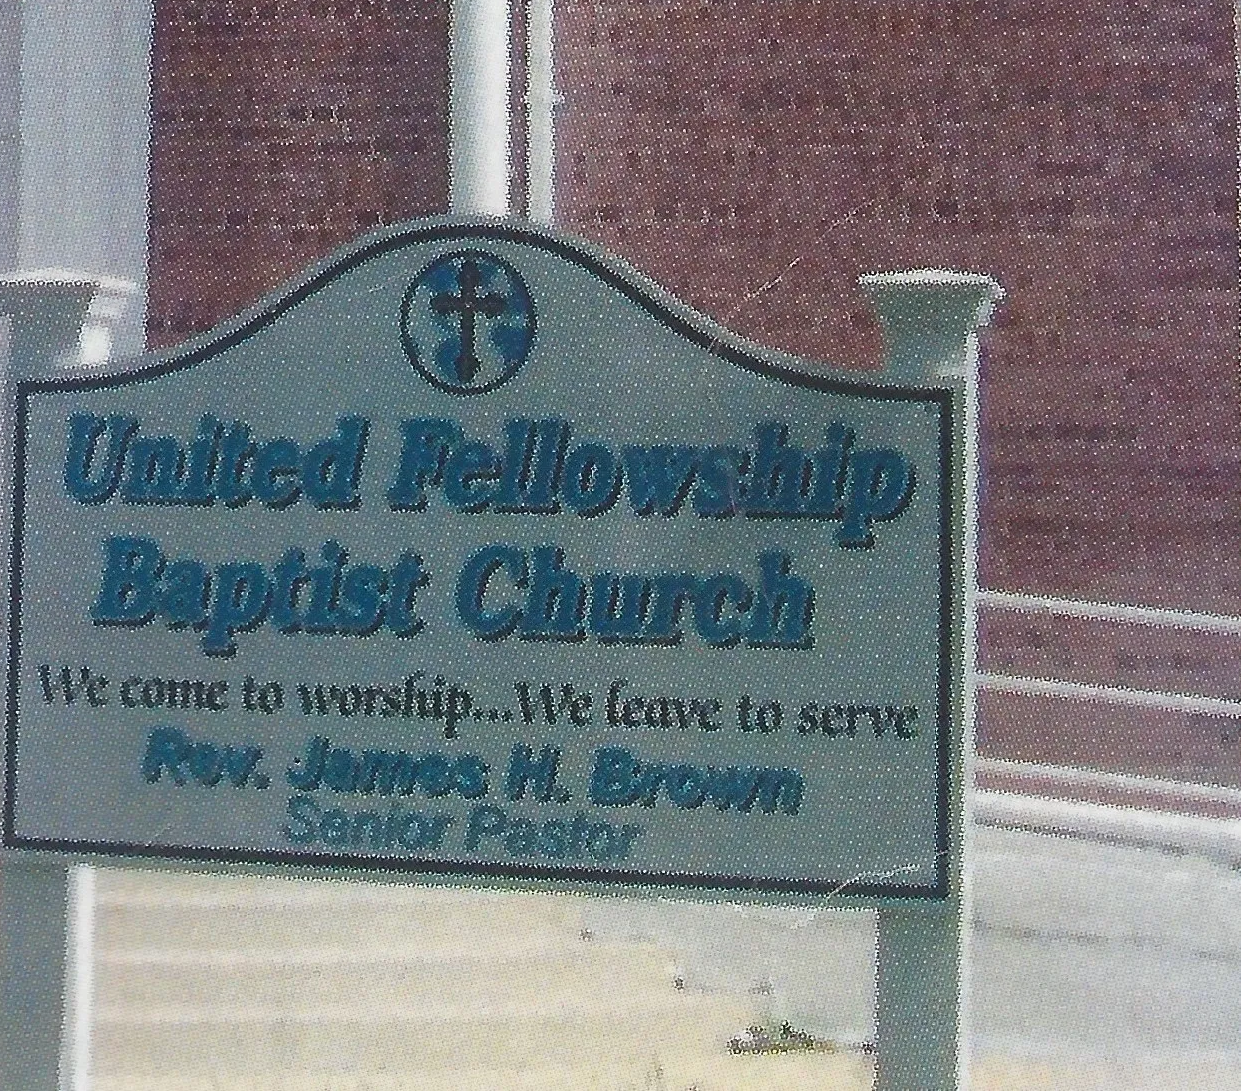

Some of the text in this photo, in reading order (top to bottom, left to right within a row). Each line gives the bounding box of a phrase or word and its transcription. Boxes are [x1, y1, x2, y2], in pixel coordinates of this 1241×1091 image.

[63, 412, 917, 550] United Fellowship
[91, 535, 816, 658] Baptist Church
[37, 664, 110, 709] We
[119, 674, 232, 712] come
[241, 674, 286, 715] to
[605, 677, 724, 733] leave
[735, 692, 784, 735] to
[795, 700, 920, 741] serve
[140, 725, 805, 817] Rev. James H. Brown
[284, 794, 645, 863] Senior Pastor
